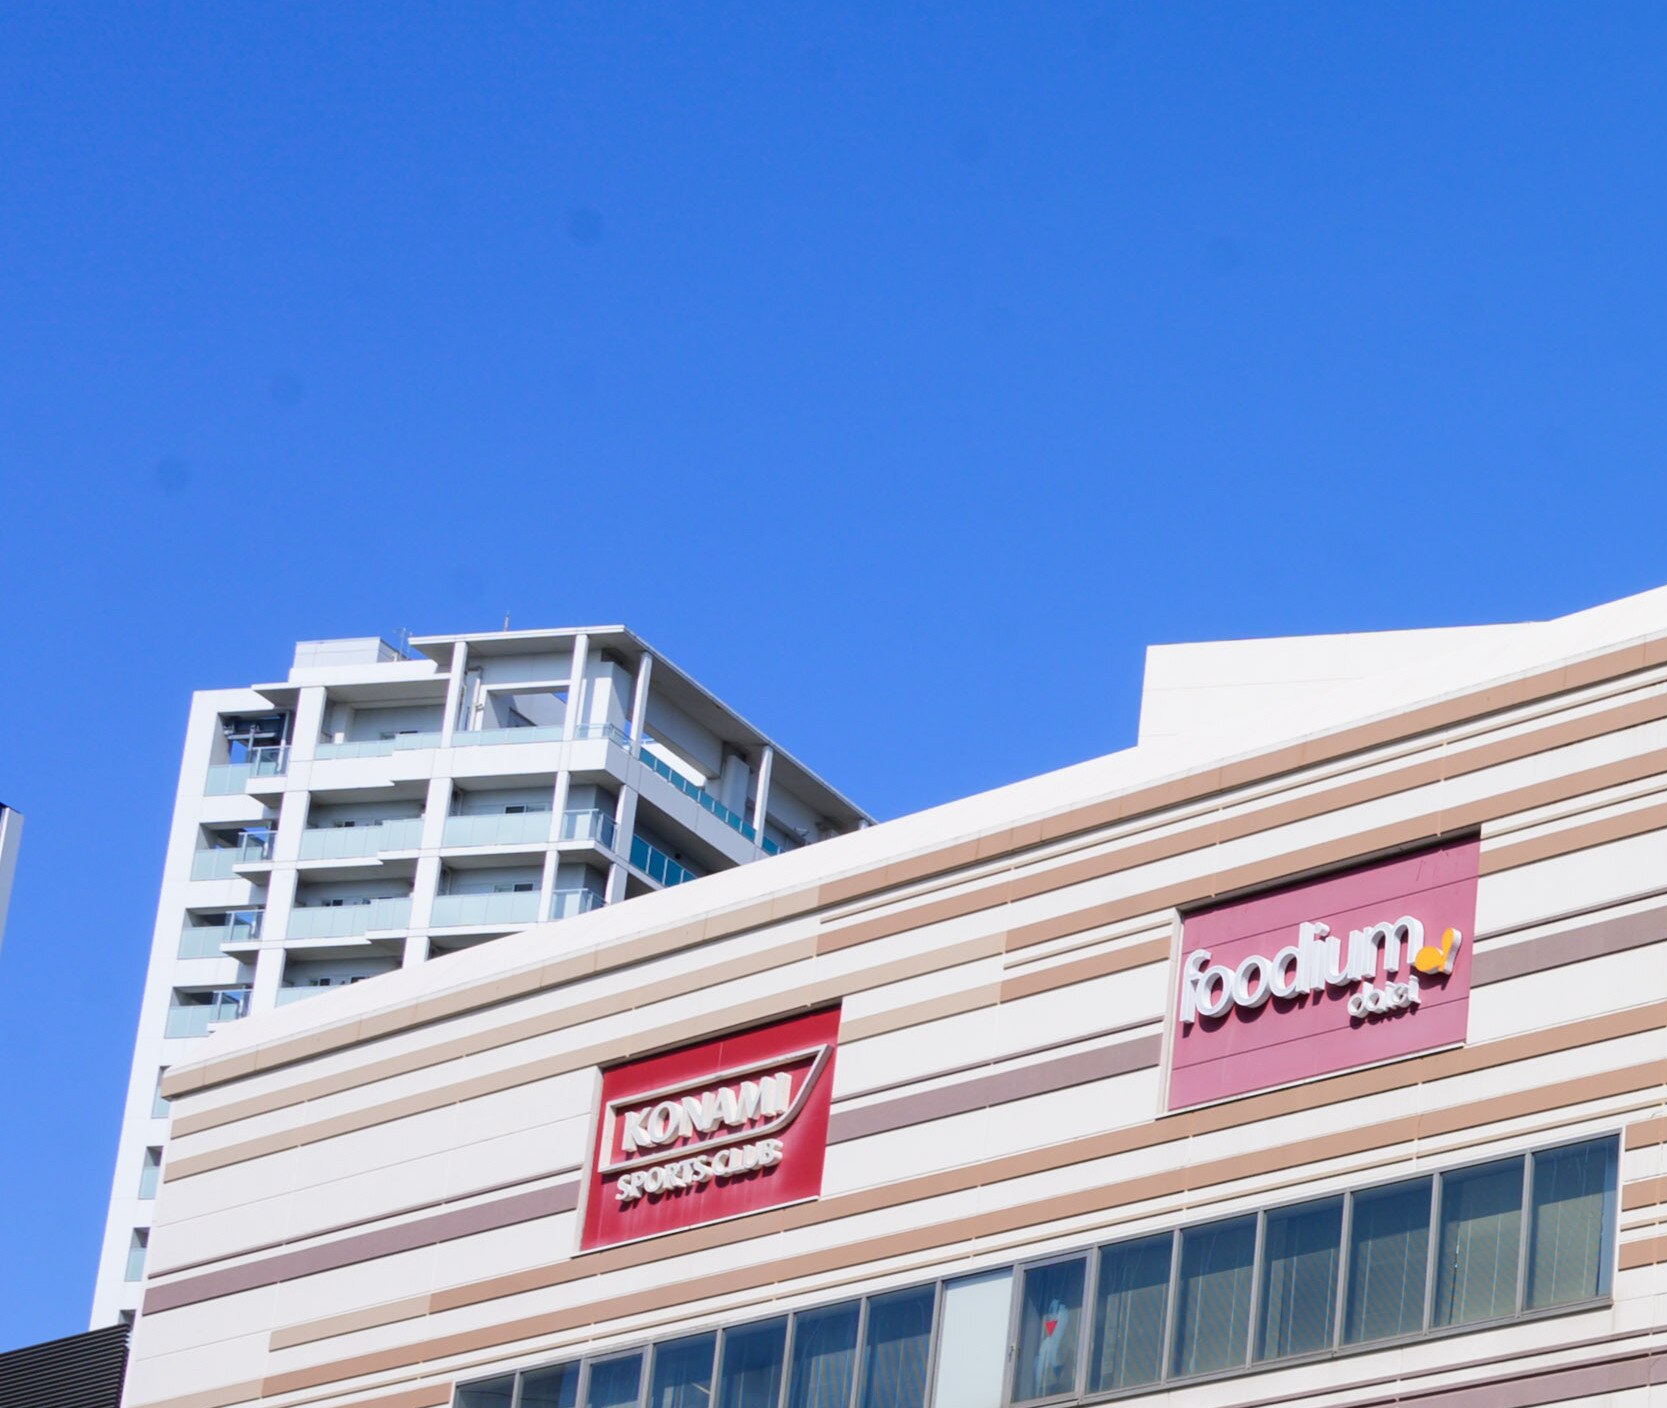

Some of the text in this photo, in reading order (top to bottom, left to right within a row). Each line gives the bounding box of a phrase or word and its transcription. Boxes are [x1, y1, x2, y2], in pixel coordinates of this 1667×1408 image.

[1180, 915, 1424, 1023] foodium
[622, 1072, 792, 1152] KONAMI
[615, 1138, 783, 1202] SPORTS CLUB
